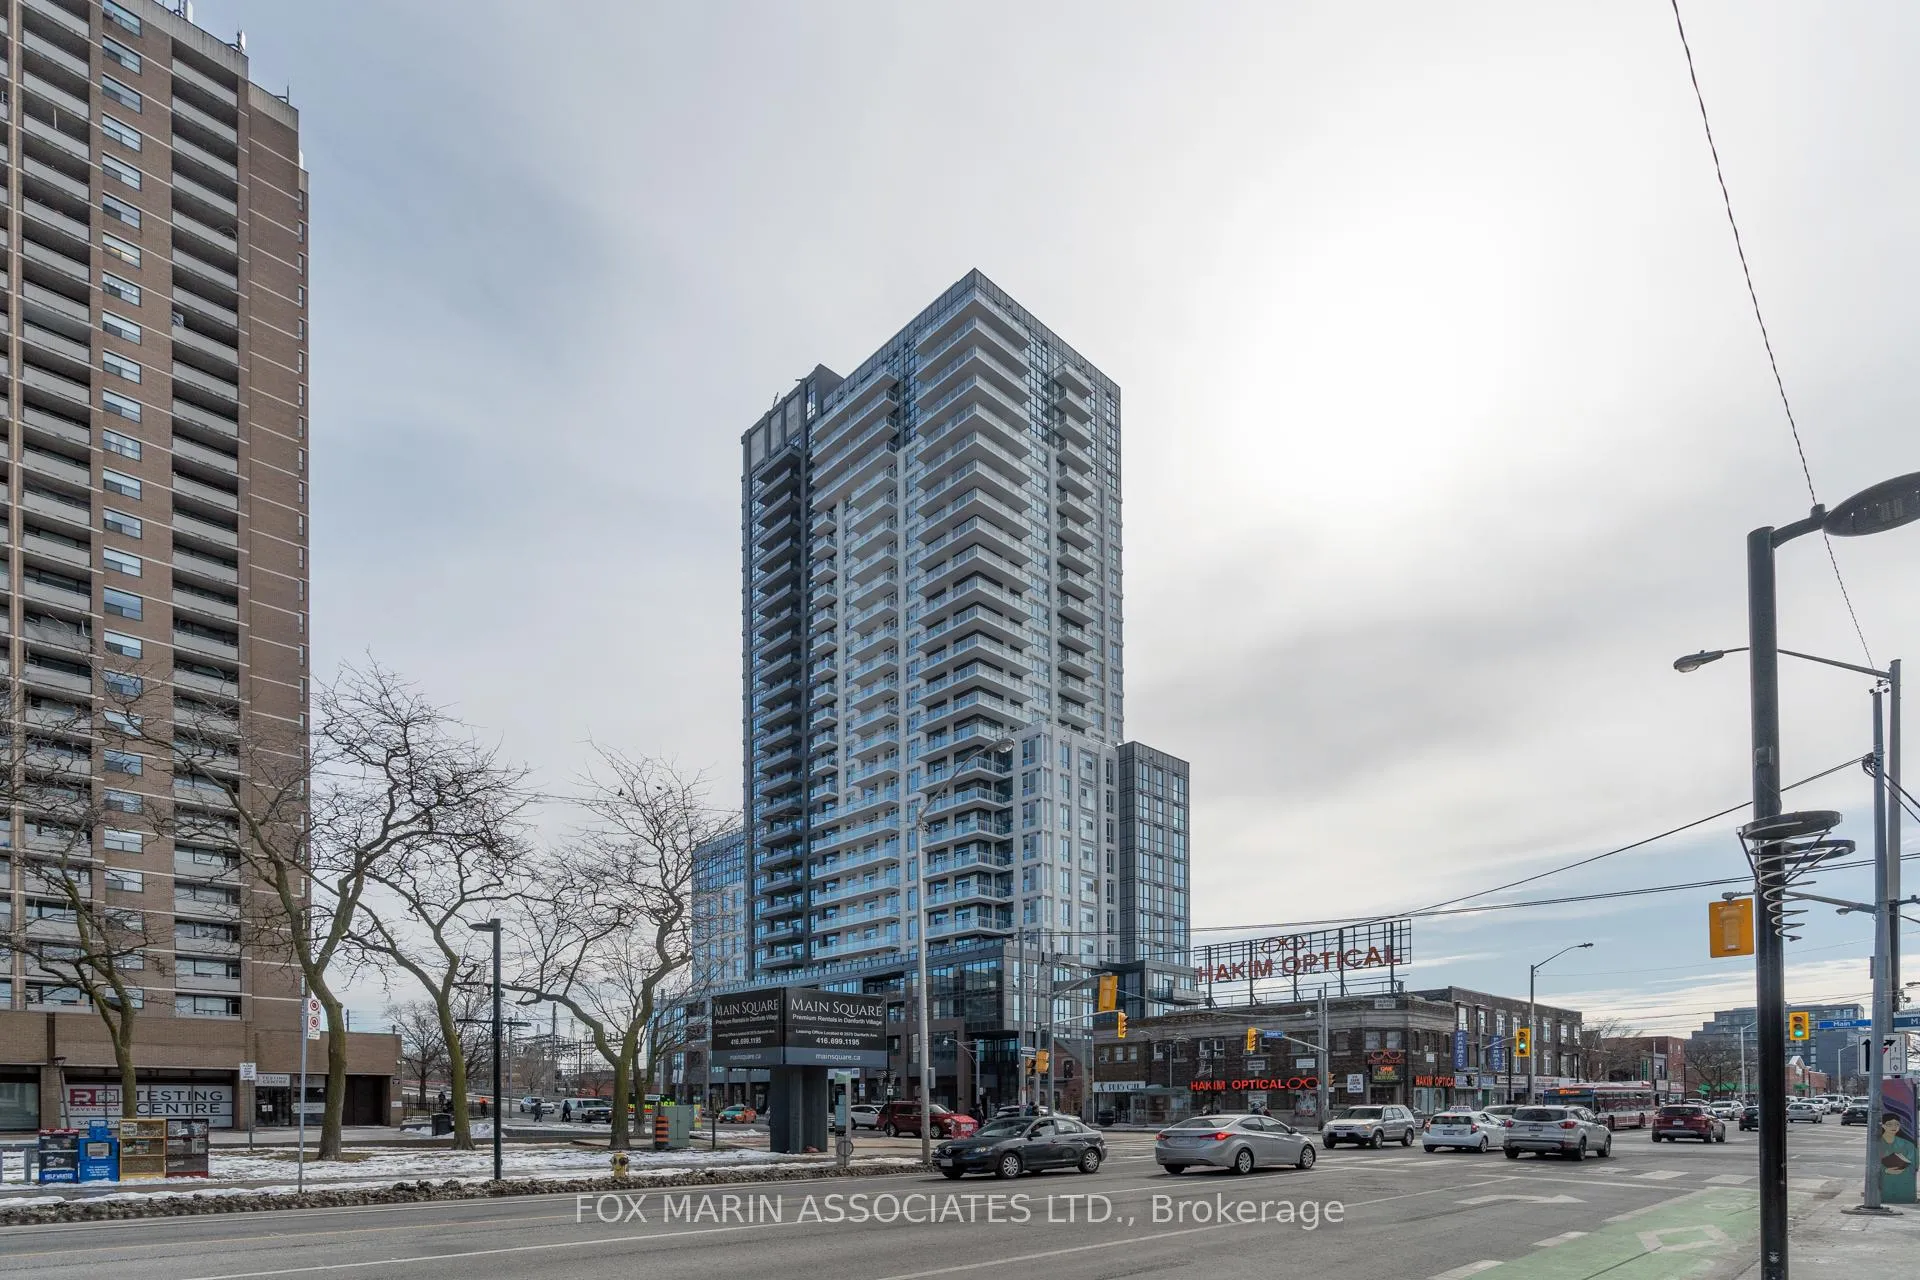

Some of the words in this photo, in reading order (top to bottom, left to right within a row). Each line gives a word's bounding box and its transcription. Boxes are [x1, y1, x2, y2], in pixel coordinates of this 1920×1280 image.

[1197, 959, 1273, 983] HAKIM
[1282, 945, 1402, 974] OPTICAL
[714, 1003, 740, 1016] MAIN
[741, 999, 778, 1016] SQUARE
[791, 998, 829, 1013] MAIN
[832, 1001, 883, 1018] SQUARE
[792, 1013, 816, 1021] Premium
[1456, 1032, 1464, 1067] PHARMACY
[816, 1053, 860, 1061] mainsquare.ca
[1190, 1080, 1226, 1091] HAKIM
[1231, 1079, 1285, 1090] OPTICAL
[136, 1090, 223, 1101] TESTING
[136, 1103, 221, 1114] CENTRE
